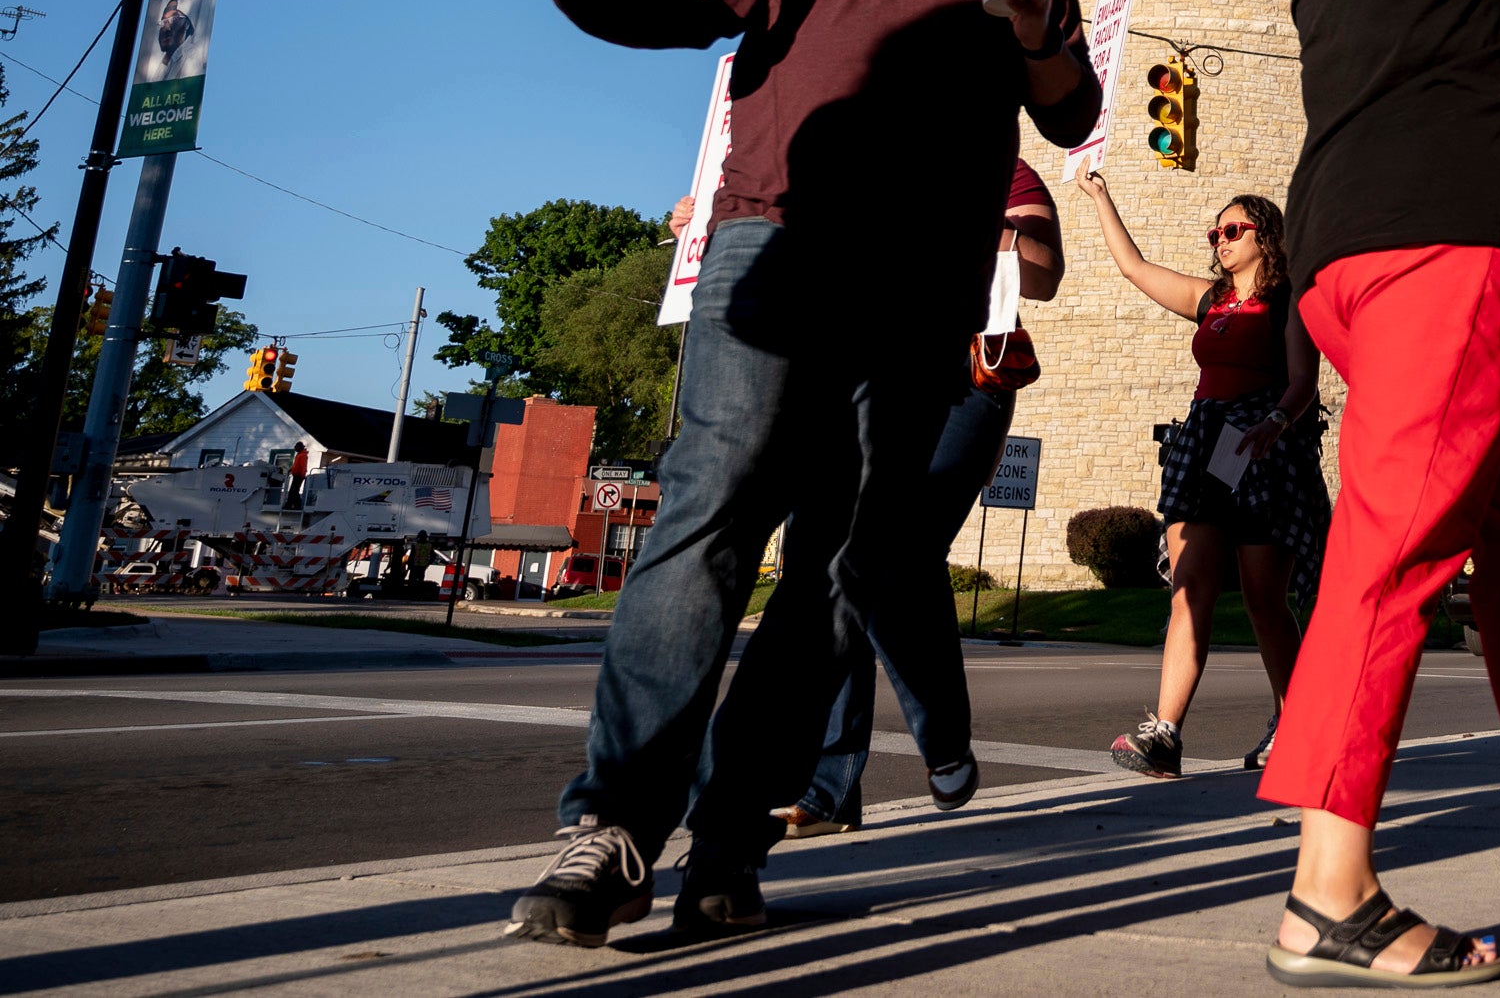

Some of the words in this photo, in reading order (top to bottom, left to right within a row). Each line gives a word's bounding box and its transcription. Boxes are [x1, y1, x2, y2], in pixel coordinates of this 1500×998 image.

[1094, 17, 1122, 49] FACULTY
[1094, 50, 1106, 69] FOR
[1105, 47, 1112, 65] A
[142, 94, 163, 109] ALL
[164, 92, 187, 106] ARE
[129, 105, 194, 128] WELCOME
[143, 126, 174, 141] HERE.
[484, 351, 513, 364] CROSS
[1005, 444, 1029, 458] ORK
[995, 464, 1028, 479] ZONE
[988, 486, 1031, 501] BEGINS
